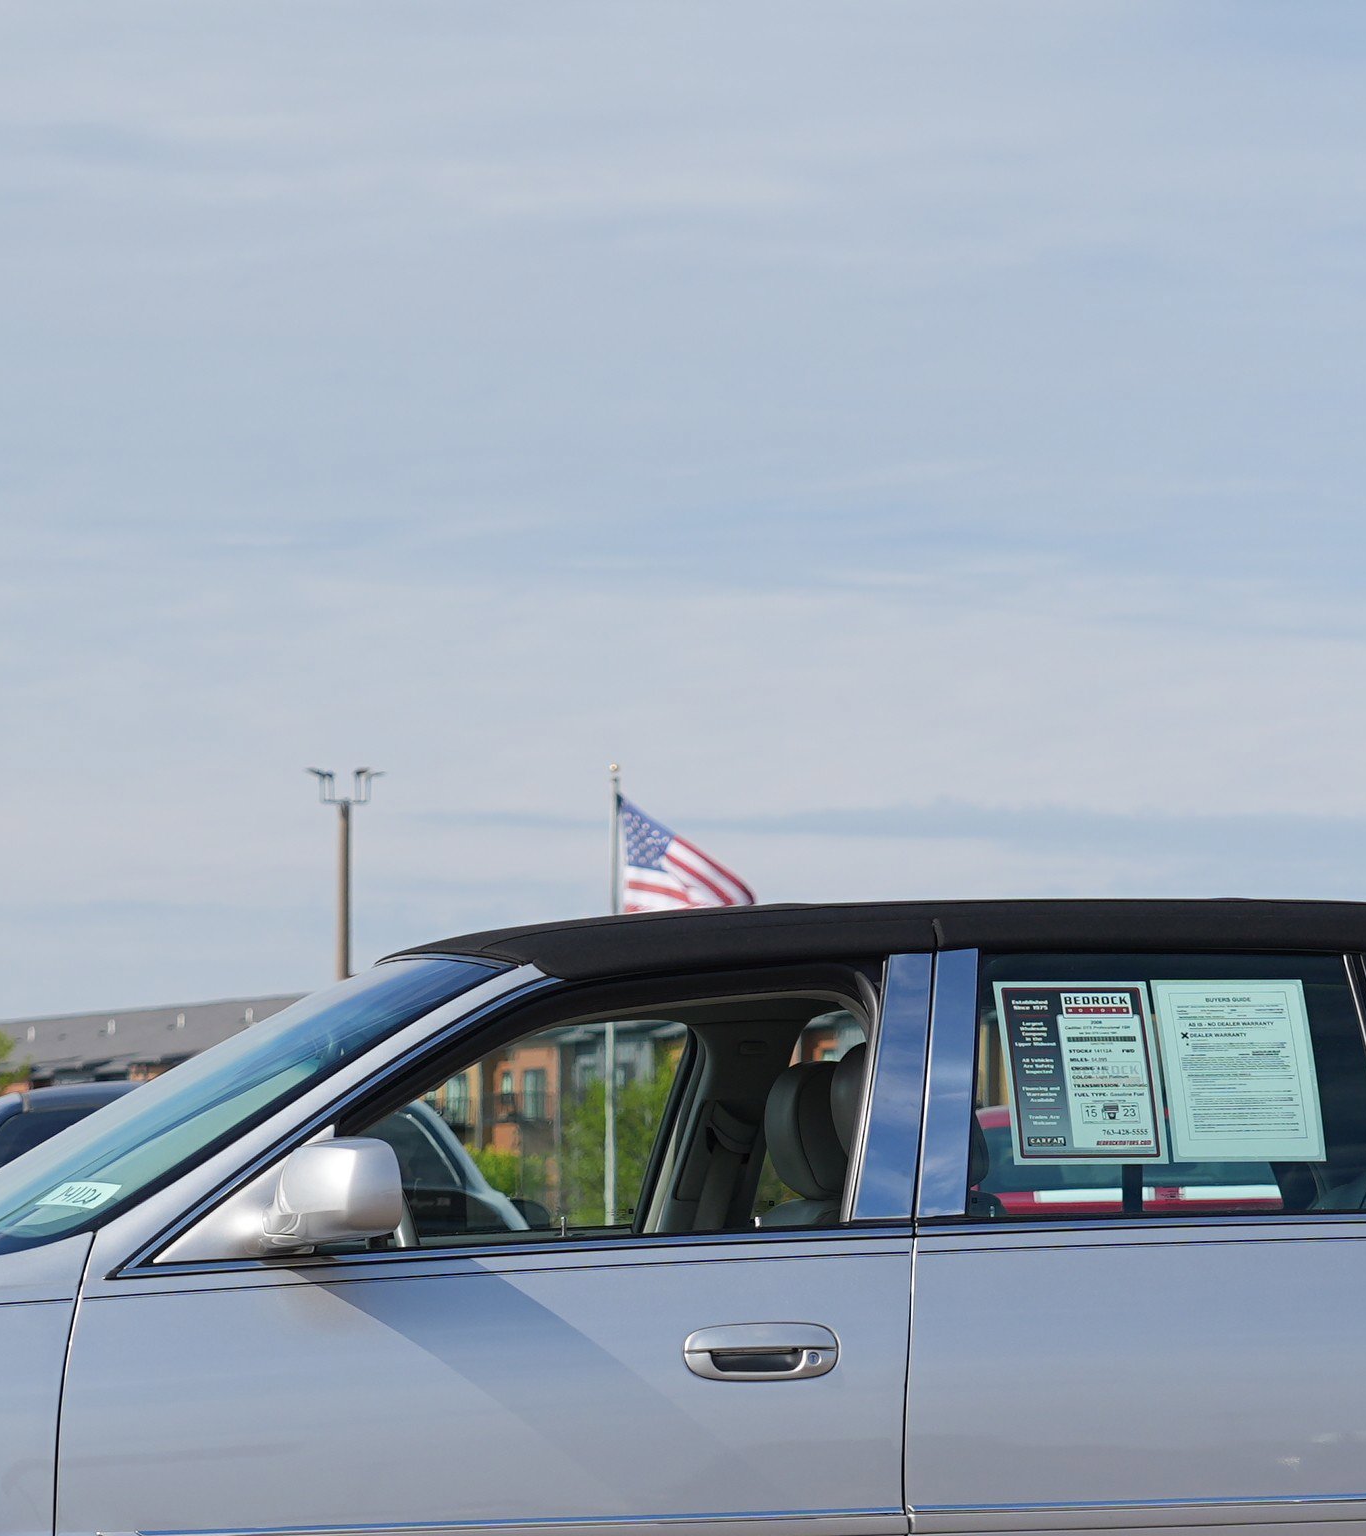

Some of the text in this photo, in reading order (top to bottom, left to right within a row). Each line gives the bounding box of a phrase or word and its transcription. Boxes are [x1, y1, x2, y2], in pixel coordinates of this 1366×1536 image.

[1064, 996, 1128, 1005] BEDROCK
[1085, 1109, 1097, 1117] 15
[1123, 1108, 1136, 1117] 23
